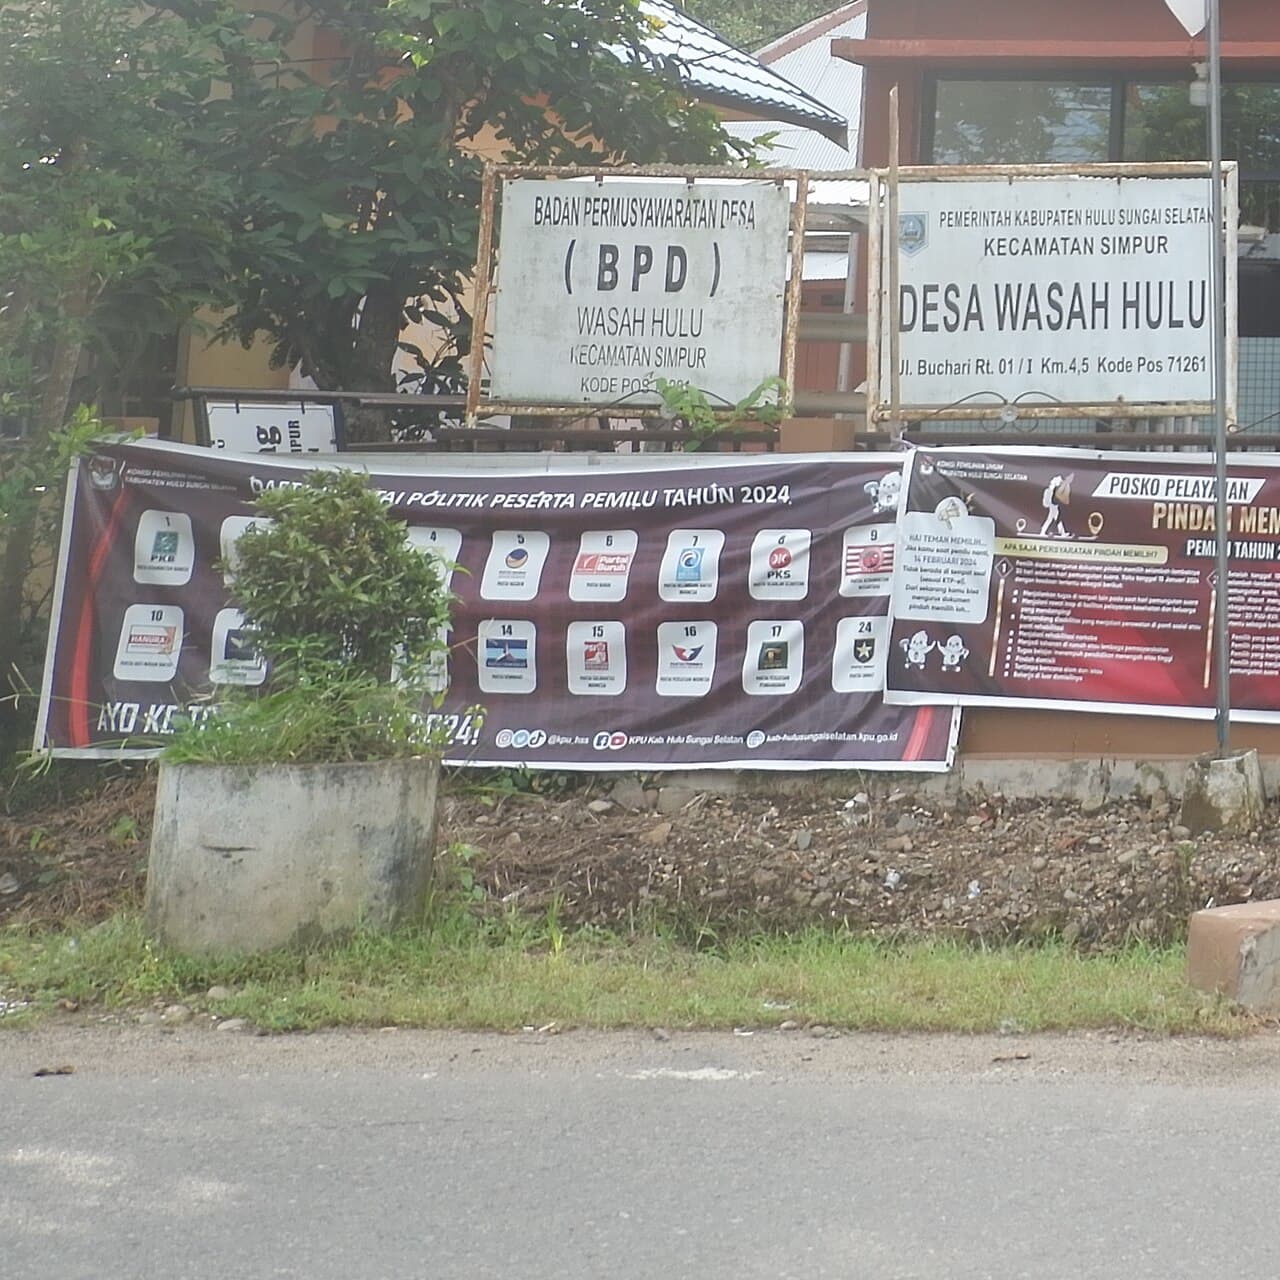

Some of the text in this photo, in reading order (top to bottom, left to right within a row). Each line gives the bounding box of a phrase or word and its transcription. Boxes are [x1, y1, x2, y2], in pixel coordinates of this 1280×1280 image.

[534, 196, 581, 226] BADAN
[583, 197, 716, 229] PERMUSYAWARATAN
[939, 207, 1215, 228] PEMERINTAH KABUPATEN HULU SUNGAI SELATAN
[984, 236, 1169, 256] KECAMATAN SIMPUR
[899, 280, 1207, 333] DESA WASAH HULU
[577, 306, 704, 338] WASAH HULU
[570, 344, 707, 369] KECAMATAN SIMPUR
[917, 359, 971, 376] Buchari
[975, 358, 994, 375] Rt.
[999, 357, 1014, 374] 01
[1041, 356, 1090, 376] Km.4,5
[1098, 356, 1133, 374] Kode
[1137, 357, 1163, 373] Pos
[1167, 355, 1206, 373] 71261
[580, 376, 618, 393] KODE
[1109, 476, 1250, 501] POSKO PELAYAAN
[406, 490, 489, 508] POLITIK
[490, 490, 576, 509] PESERTA
[579, 489, 657, 508] PEMILU
[662, 486, 735, 507] TAHUN
[430, 530, 437, 542] 4
[517, 534, 525, 544] 5
[606, 535, 613, 547] 6
[692, 535, 699, 546] 7
[870, 529, 878, 541] 9
[1235, 541, 1275, 559] TAHUN
[150, 554, 175, 563] PKB
[767, 570, 792, 579] PKS
[151, 610, 163, 621] 10
[500, 624, 512, 636] 14
[592, 625, 604, 637] 15
[684, 625, 697, 637] 16
[771, 625, 782, 637] 17
[857, 621, 872, 633] 24
[97, 701, 140, 733] AYO
[629, 735, 648, 745] KPU
